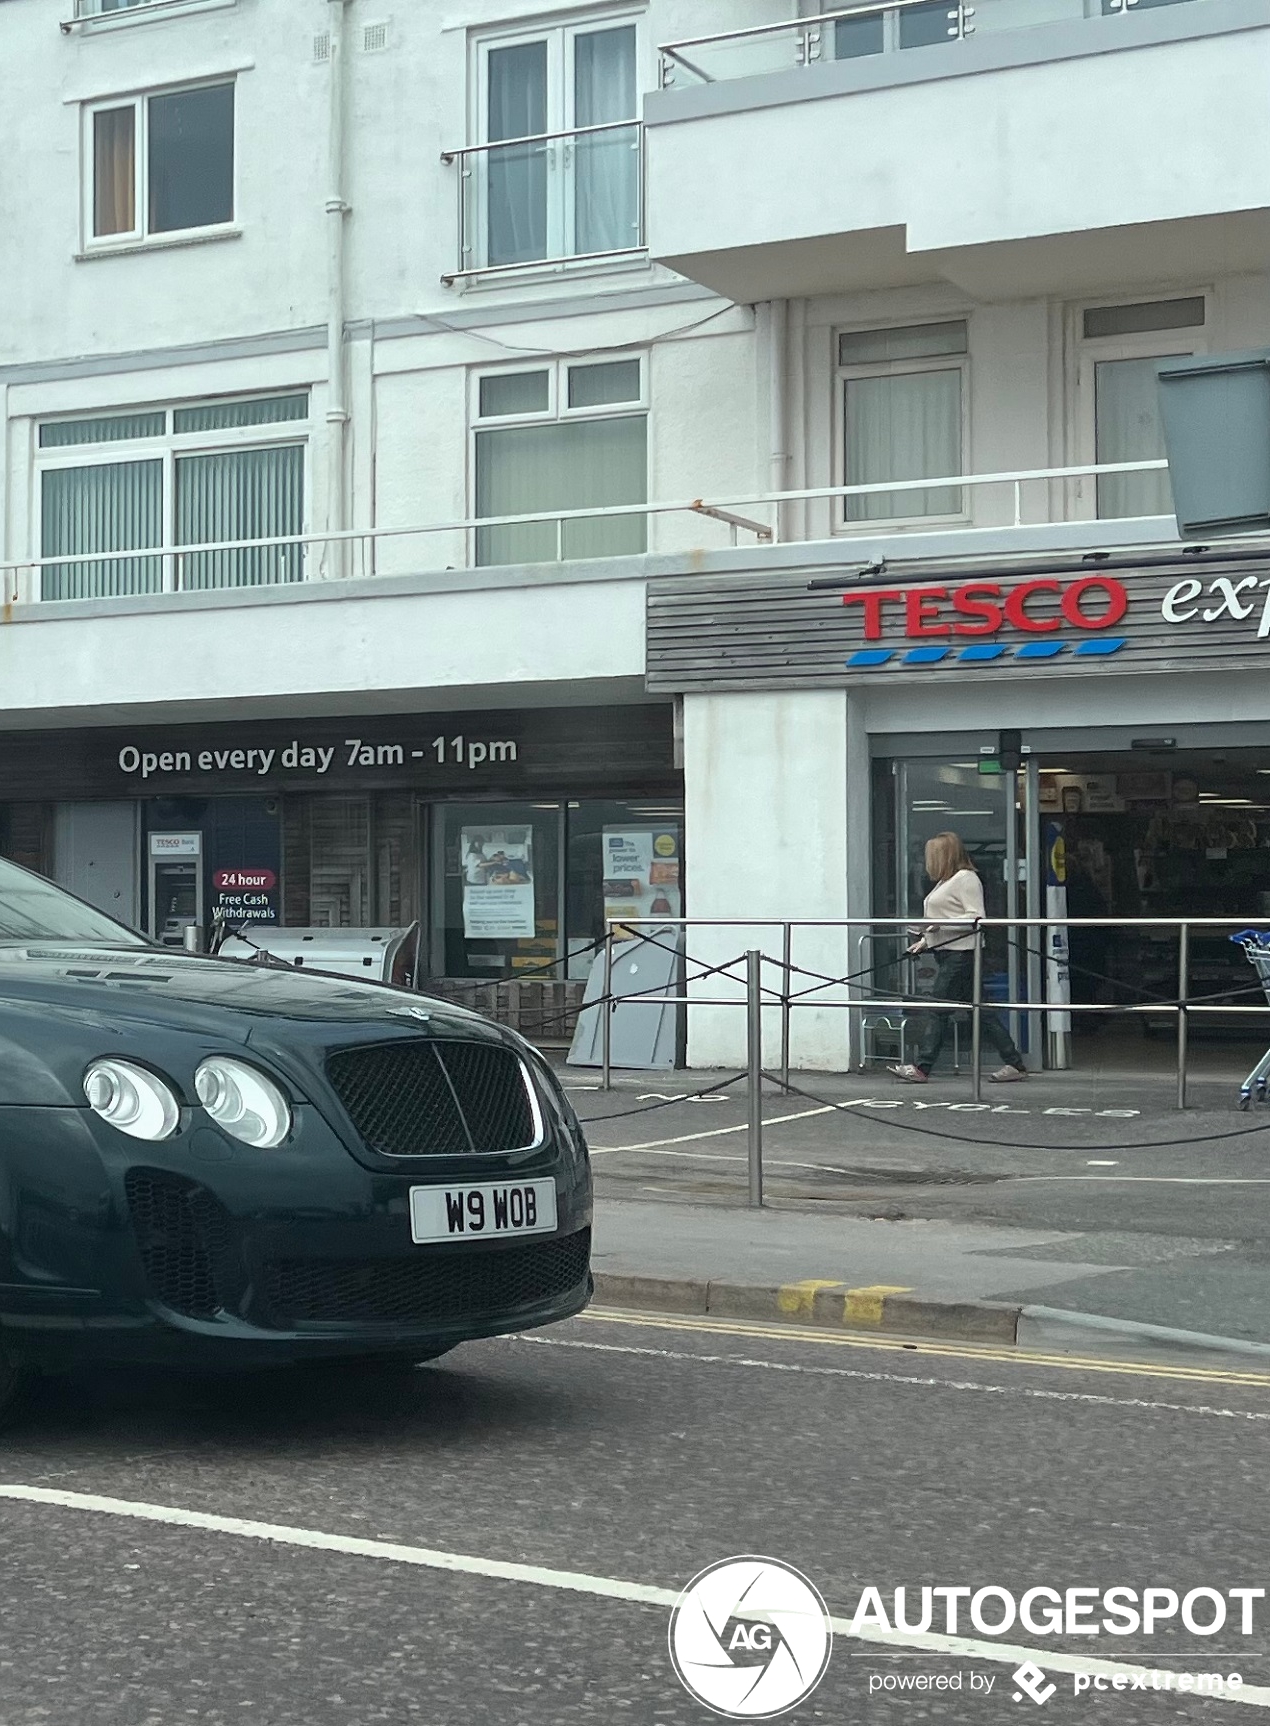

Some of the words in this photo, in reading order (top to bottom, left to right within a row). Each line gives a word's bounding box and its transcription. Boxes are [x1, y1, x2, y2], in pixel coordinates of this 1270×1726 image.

[842, 575, 1127, 640] TESCO
[118, 745, 191, 777] Open
[198, 748, 275, 775] every
[281, 741, 334, 773] day
[344, 739, 404, 766] 7am
[431, 736, 518, 769] 11pm
[612, 853, 639, 863] lower
[221, 873, 236, 886] 24
[238, 873, 267, 886] hour
[219, 892, 241, 905] Free
[243, 892, 268, 905] Cash
[212, 906, 276, 919] Withdrawals
[445, 1190, 485, 1233] W9
[493, 1187, 538, 1229] WOB
